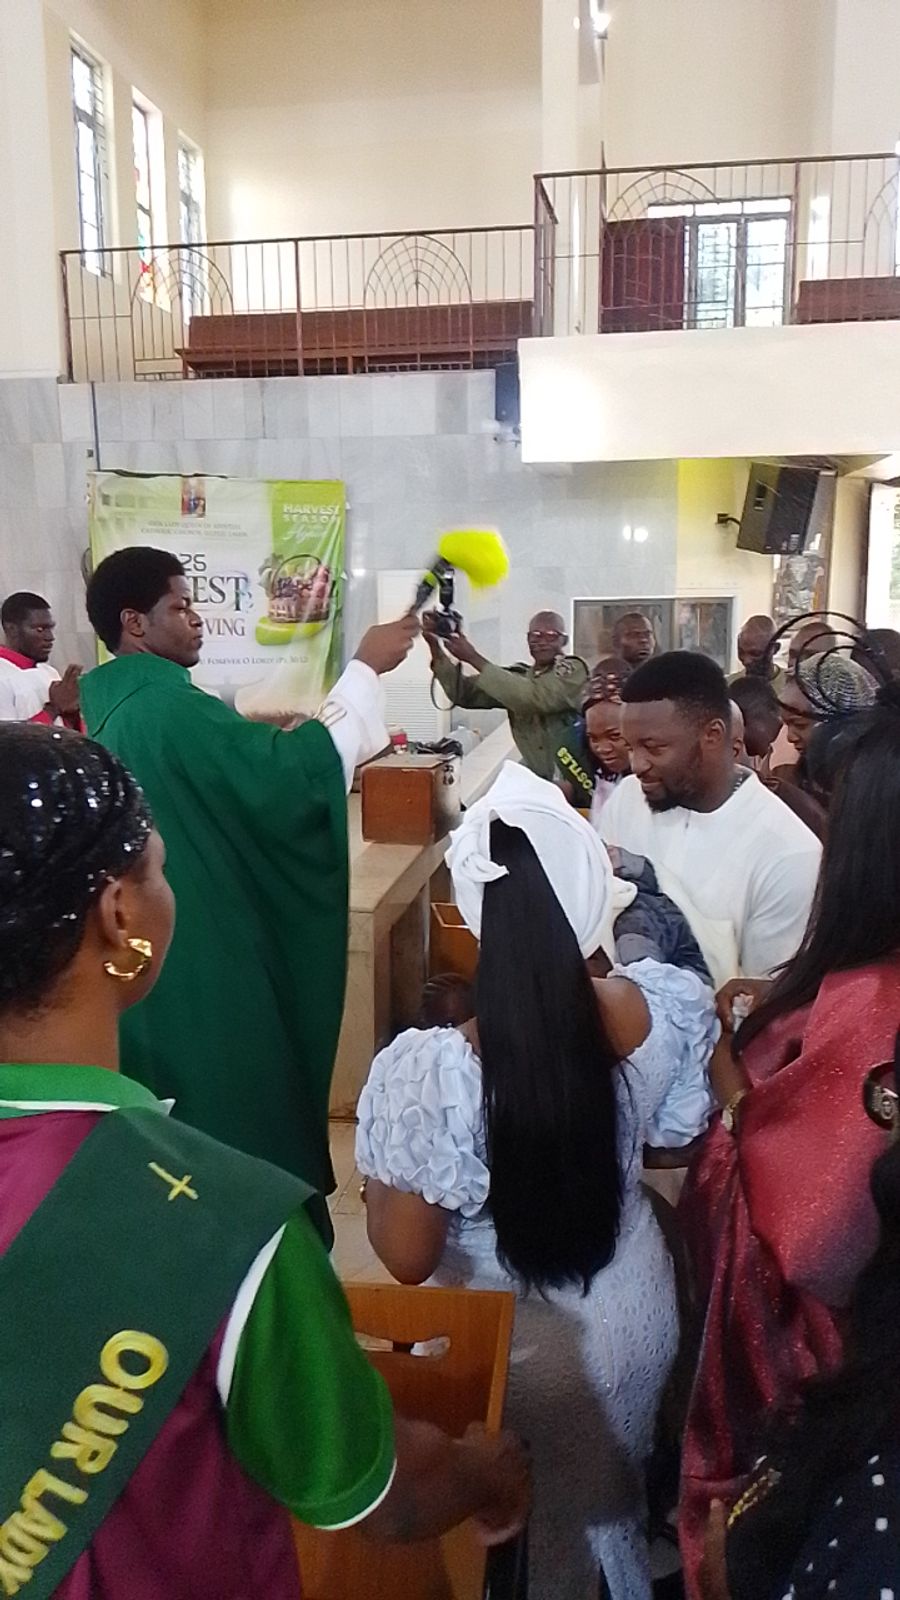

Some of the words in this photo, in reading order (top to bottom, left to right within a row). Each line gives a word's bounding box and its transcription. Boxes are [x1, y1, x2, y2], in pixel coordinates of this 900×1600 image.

[187, 575, 249, 611] EST
[203, 617, 246, 637] VING
[556, 747, 594, 794] OSTLES
[50, 1330, 169, 1473] OUR
[0, 1467, 89, 1597] LADY
